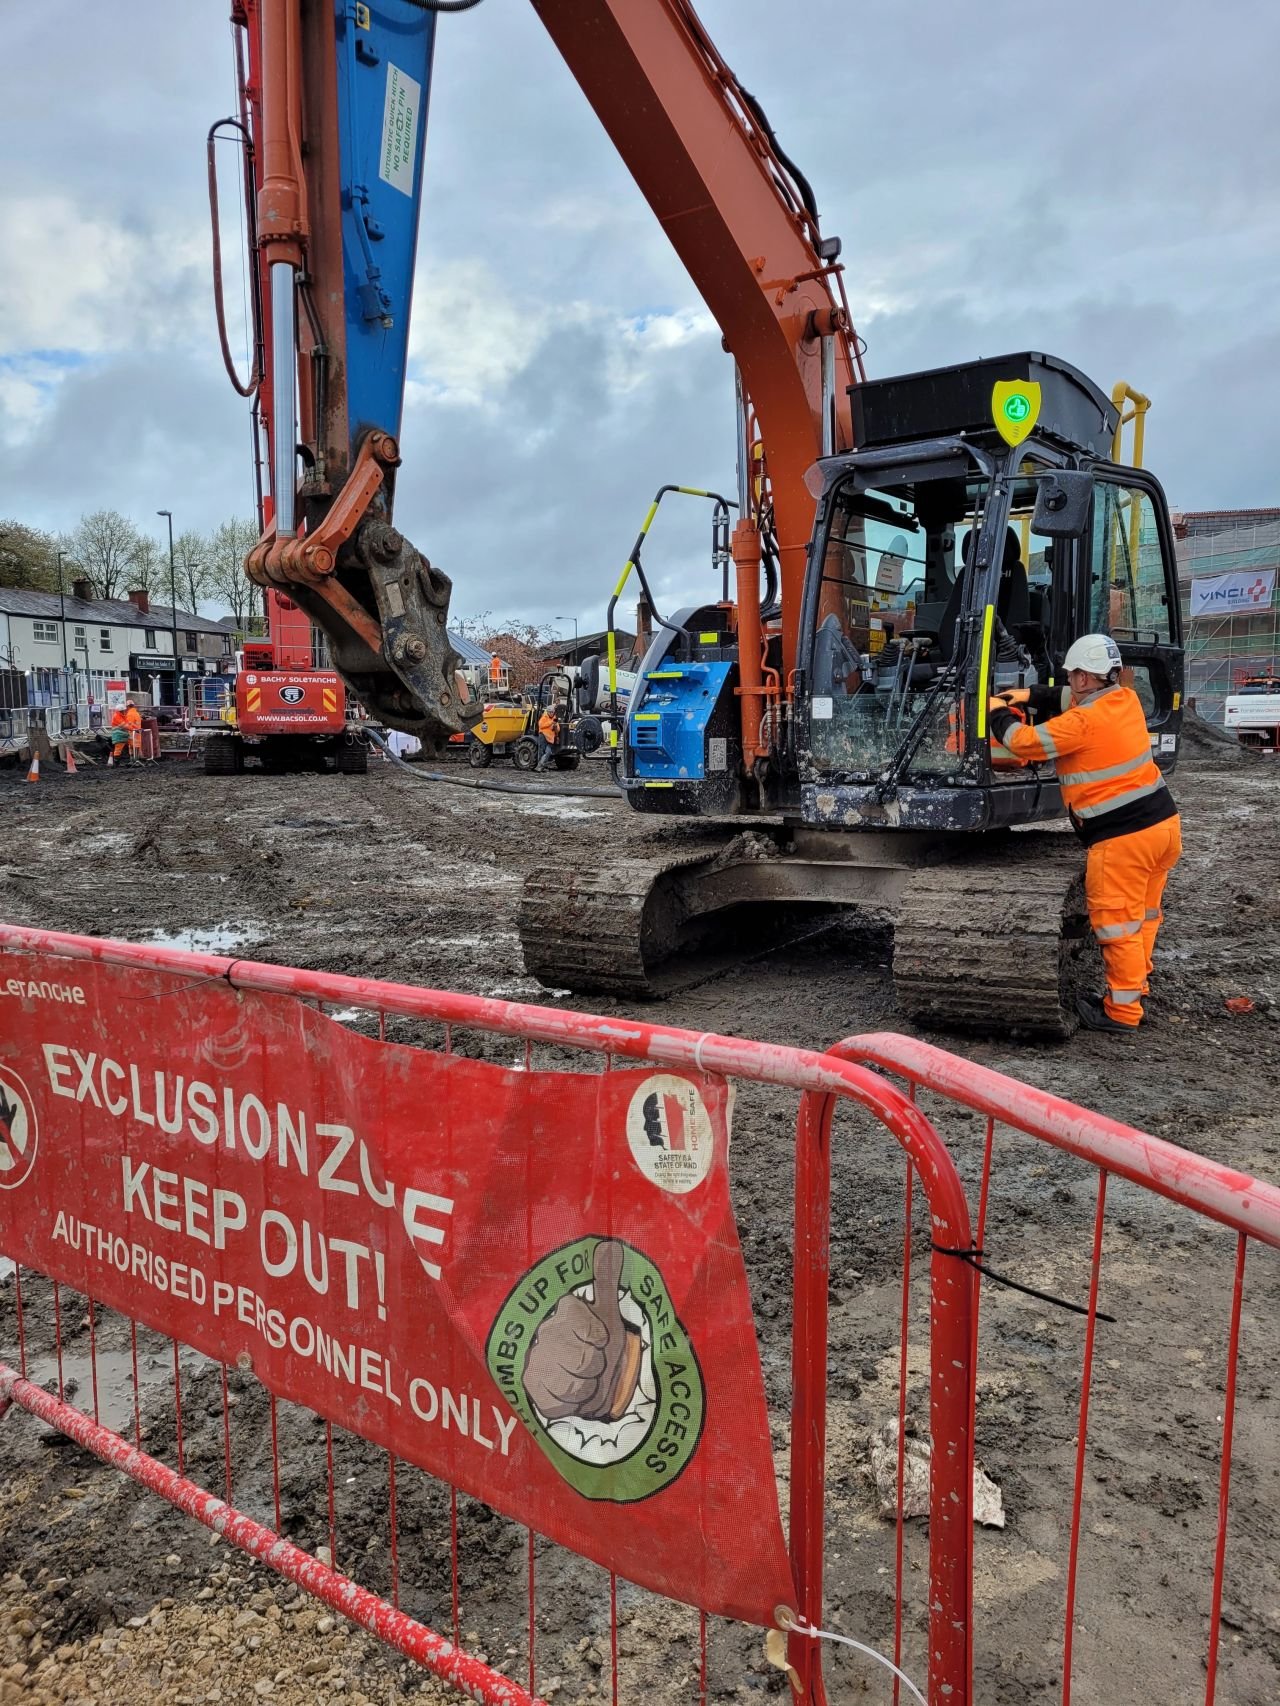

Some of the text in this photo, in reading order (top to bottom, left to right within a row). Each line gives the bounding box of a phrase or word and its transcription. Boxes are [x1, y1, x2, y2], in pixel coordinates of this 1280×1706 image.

[384, 129, 394, 180] AUTOMATIC
[389, 100, 397, 127] QUICK
[395, 109, 404, 153] SAFETY
[402, 107, 413, 164] REQUIRED
[393, 155, 400, 172] NO
[1199, 587, 1244, 600] VINCI
[688, 1088, 698, 1151] HOME SAFE
[42, 1043, 455, 1281] EXCLUSION ZOE
[658, 1154, 682, 1162] SAFETY
[121, 1156, 387, 1322] KEEP OUT!
[52, 1210, 517, 1456] AUTHORISED PERSONNEL ONLY
[497, 1249, 692, 1474] UMBS UP FOR SAFE ACCESS
